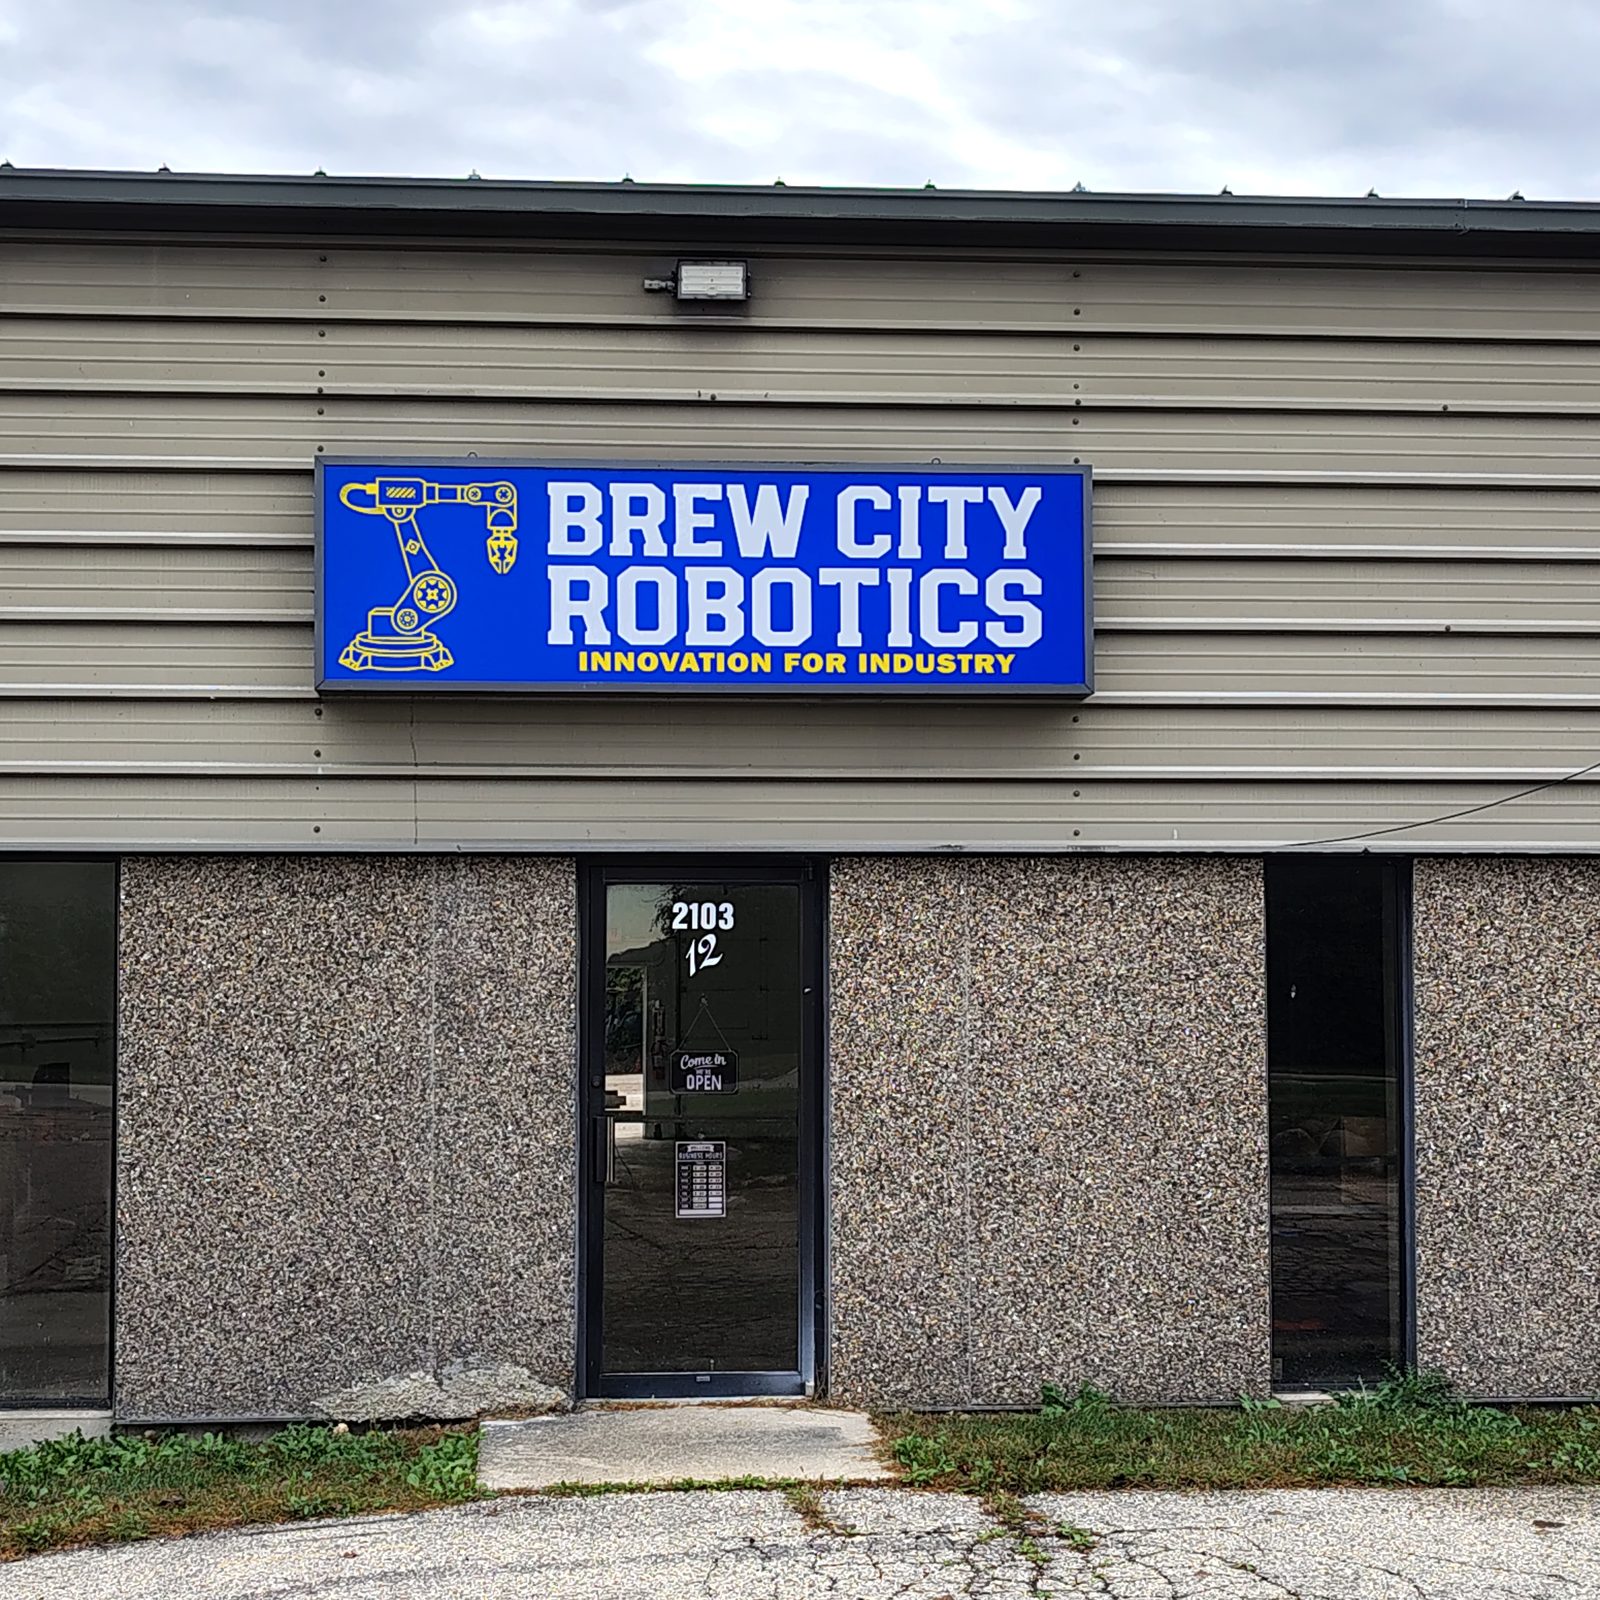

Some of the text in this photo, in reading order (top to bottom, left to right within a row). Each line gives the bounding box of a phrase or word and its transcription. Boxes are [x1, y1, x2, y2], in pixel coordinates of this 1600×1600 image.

[547, 481, 1042, 559] BREW CITY
[547, 564, 1042, 648] ROBOTICS
[579, 651, 1016, 674] INNOVATION FOR INDUSTRY
[671, 901, 734, 930] 2103
[685, 933, 723, 977] 12
[680, 1053, 727, 1069] Come in
[686, 1074, 722, 1091] OPEN
